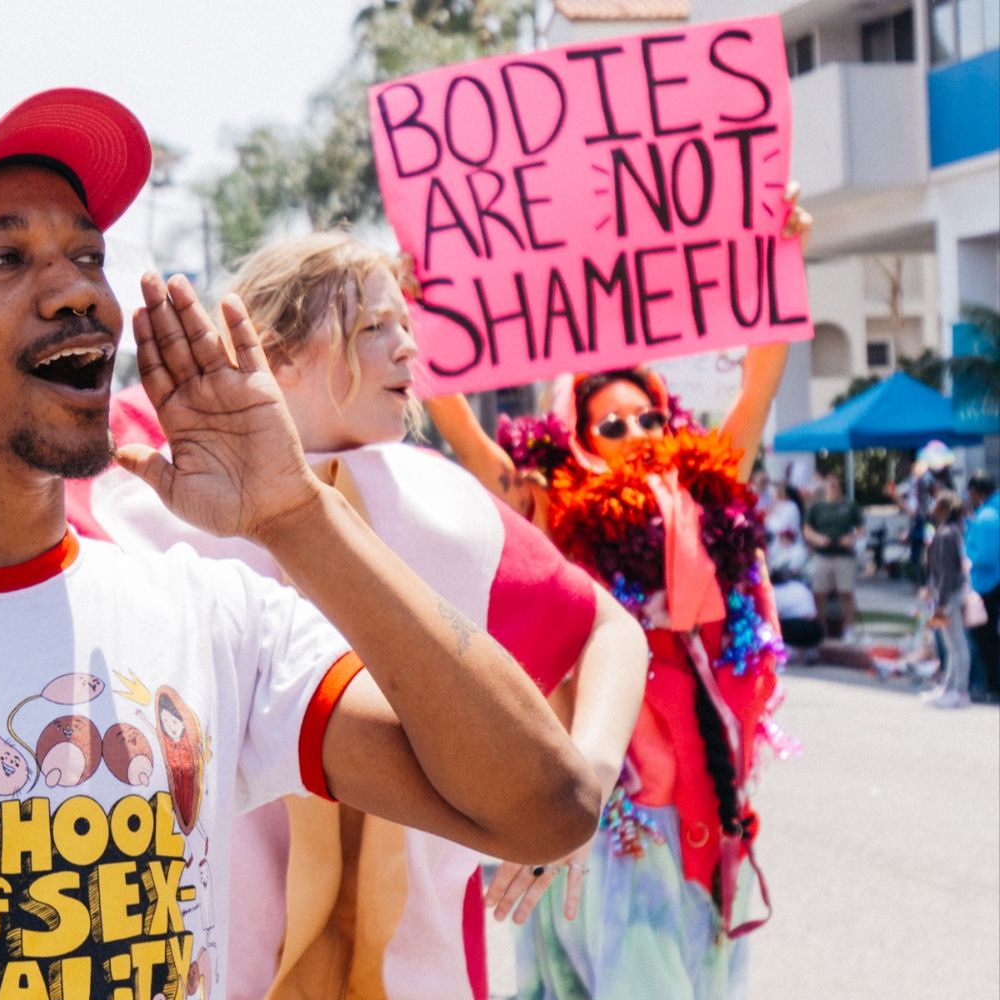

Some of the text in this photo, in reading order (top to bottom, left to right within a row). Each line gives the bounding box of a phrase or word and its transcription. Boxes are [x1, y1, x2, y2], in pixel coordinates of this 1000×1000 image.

[377, 29, 772, 178] BODIES
[423, 125, 777, 271] ARE NOT
[414, 235, 807, 377] SHAMEFUL
[7, 859, 197, 958] SEX-
